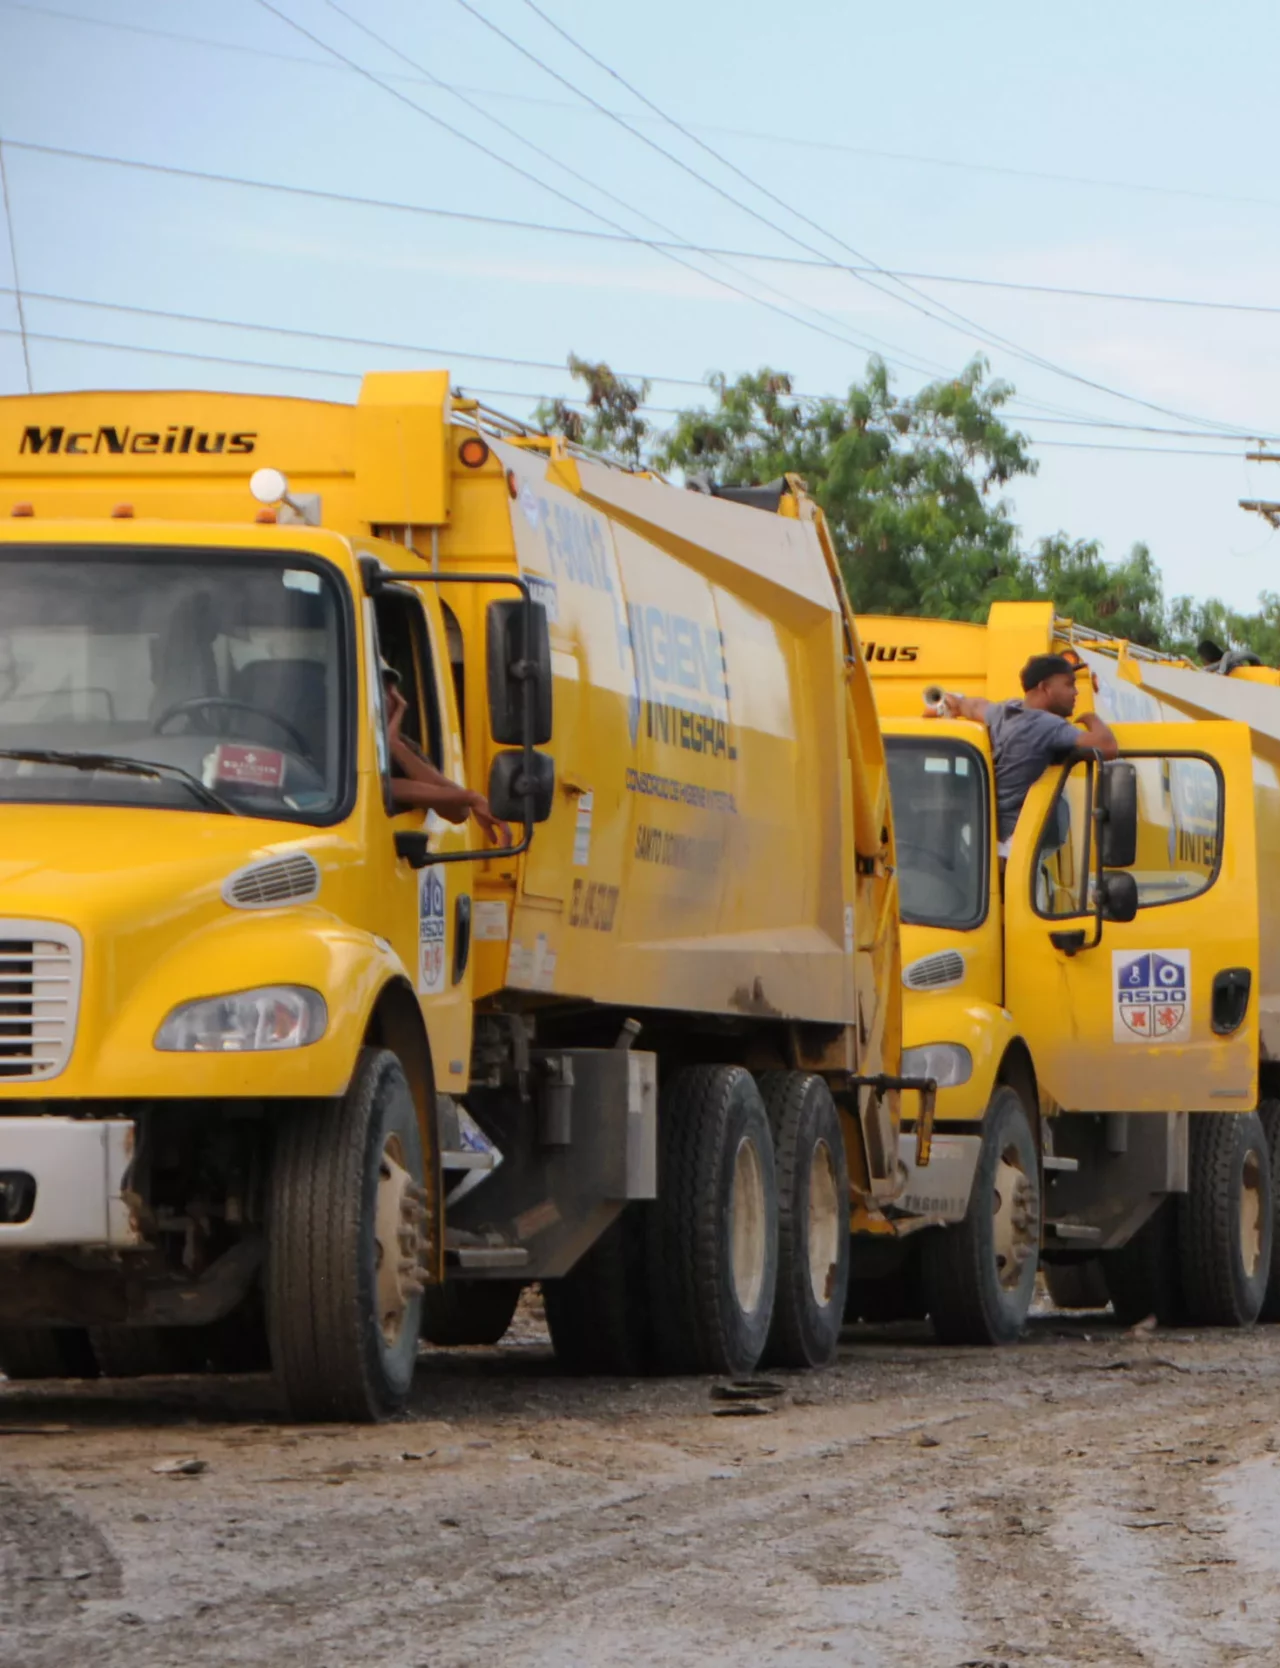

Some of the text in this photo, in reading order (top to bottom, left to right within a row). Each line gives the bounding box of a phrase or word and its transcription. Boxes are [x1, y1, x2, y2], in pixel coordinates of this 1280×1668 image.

[19, 425, 258, 455] McNeilus
[861, 642, 920, 662] lus
[646, 683, 737, 760] INTEGRAL
